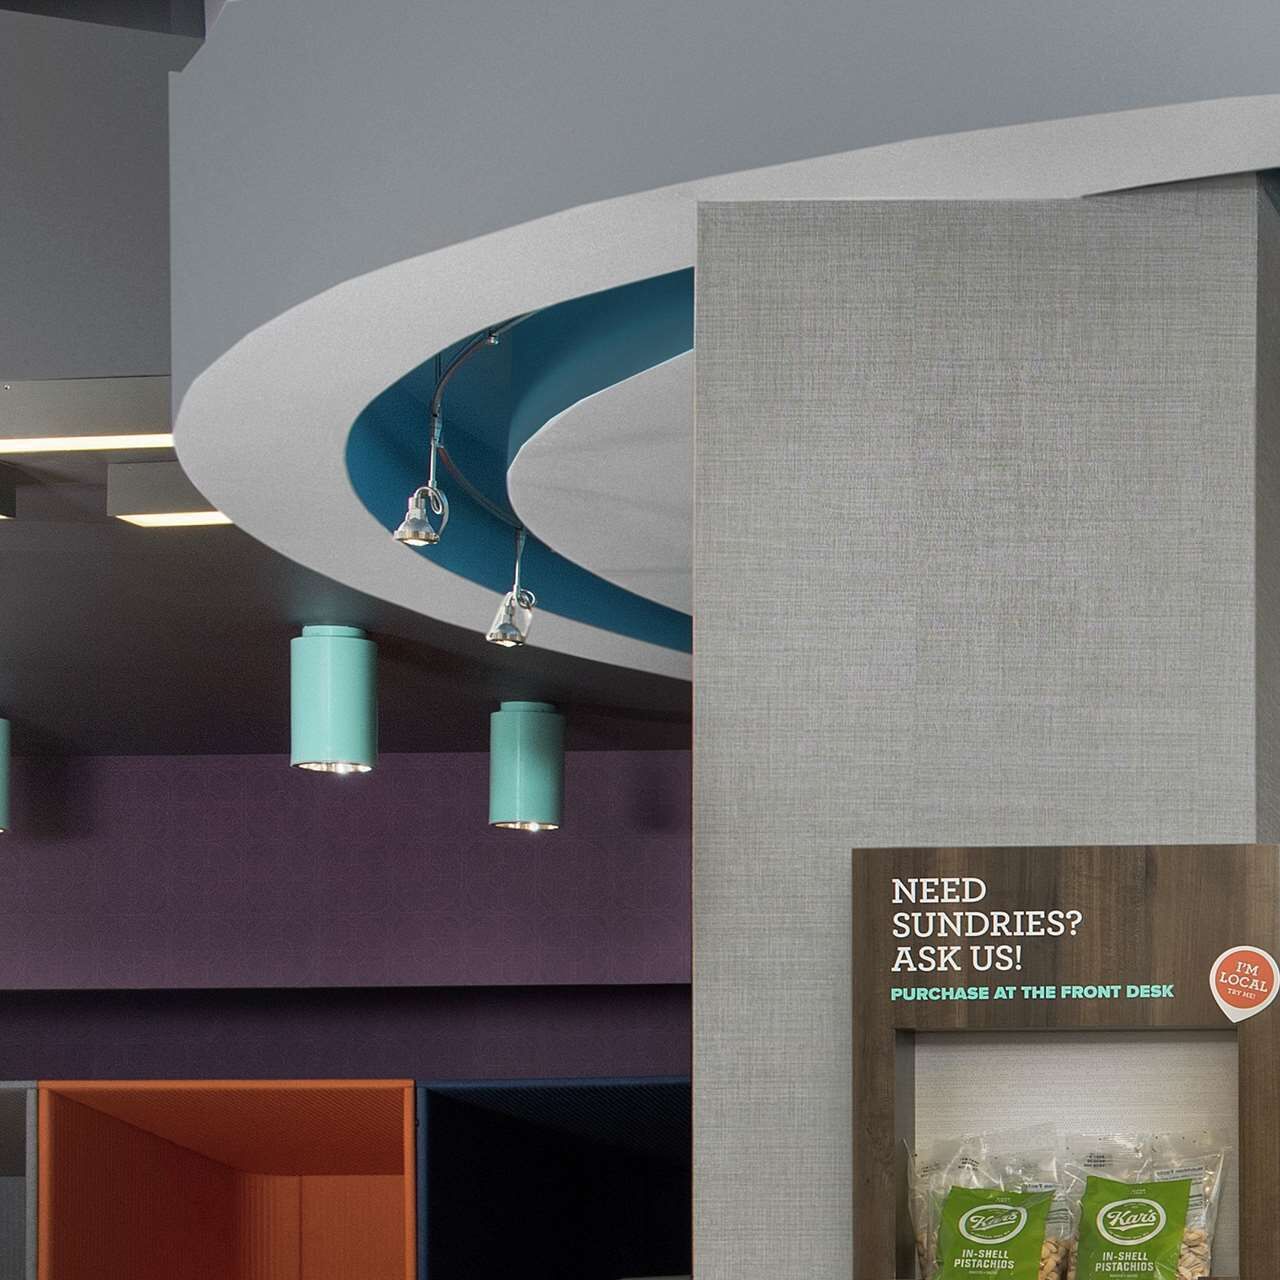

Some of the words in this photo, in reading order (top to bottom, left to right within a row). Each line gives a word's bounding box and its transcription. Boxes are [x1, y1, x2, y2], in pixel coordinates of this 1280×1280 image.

[891, 878, 987, 904] NEED
[892, 911, 1082, 938] SUNDRIES?
[890, 947, 961, 973] ASK
[971, 944, 1023, 972] US!
[1236, 961, 1258, 976] I'M
[1219, 971, 1268, 993] LOCAL
[891, 987, 989, 1001] PURCHASE
[993, 986, 1018, 1000] AT
[1021, 986, 1056, 1000] THE
[1061, 985, 1121, 999] FRONT
[1126, 984, 1175, 998] DESK
[1106, 1210, 1157, 1233] Kar's
[962, 1249, 1009, 1259] IN-SHELL
[1102, 1251, 1148, 1261] IN-SHELL
[954, 1258, 1015, 1269] PISTACHIOS
[1095, 1262, 1154, 1272] PISTACHIOS
